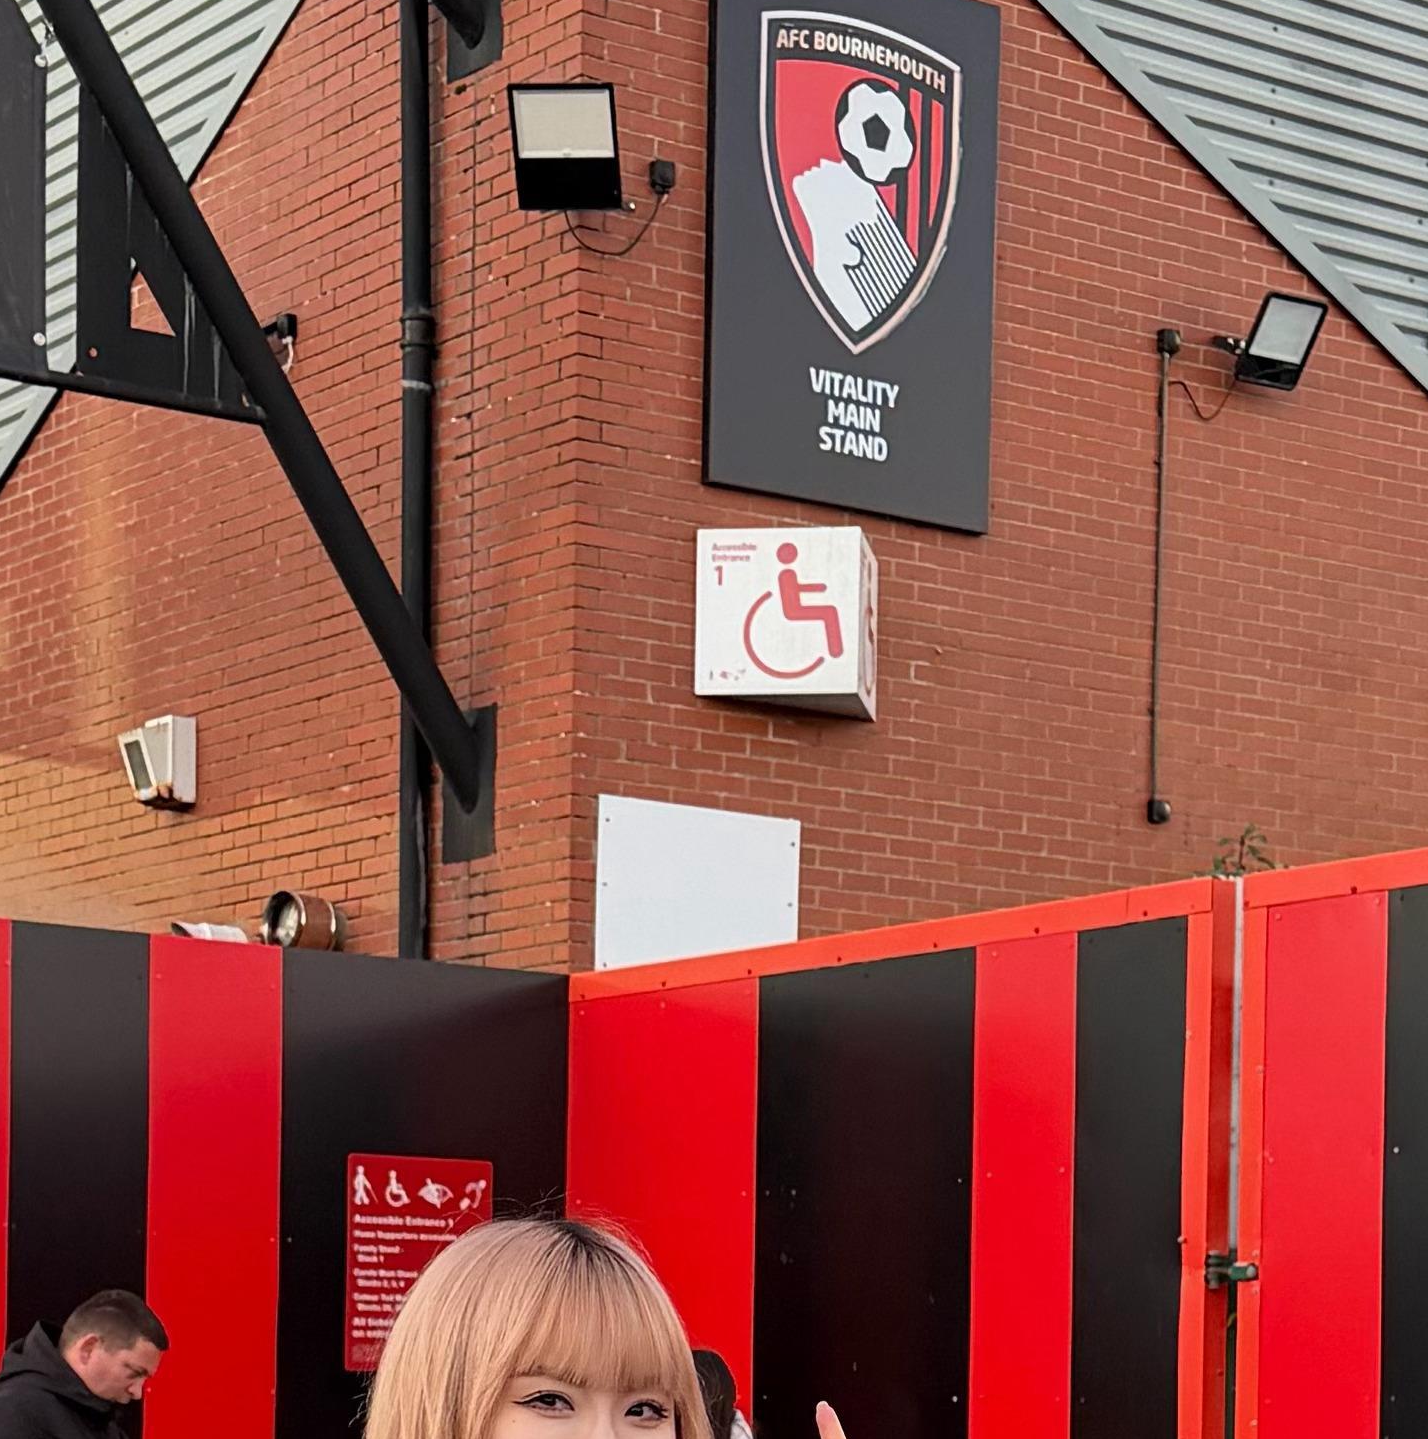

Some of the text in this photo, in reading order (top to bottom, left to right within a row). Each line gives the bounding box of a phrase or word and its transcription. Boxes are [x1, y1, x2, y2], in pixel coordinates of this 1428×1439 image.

[776, 28, 946, 94] AFC BOURNEMOUTH
[809, 366, 899, 408] VITALITY
[828, 399, 880, 433] MAIN
[819, 426, 888, 462] STAND
[714, 565, 723, 586] 1
